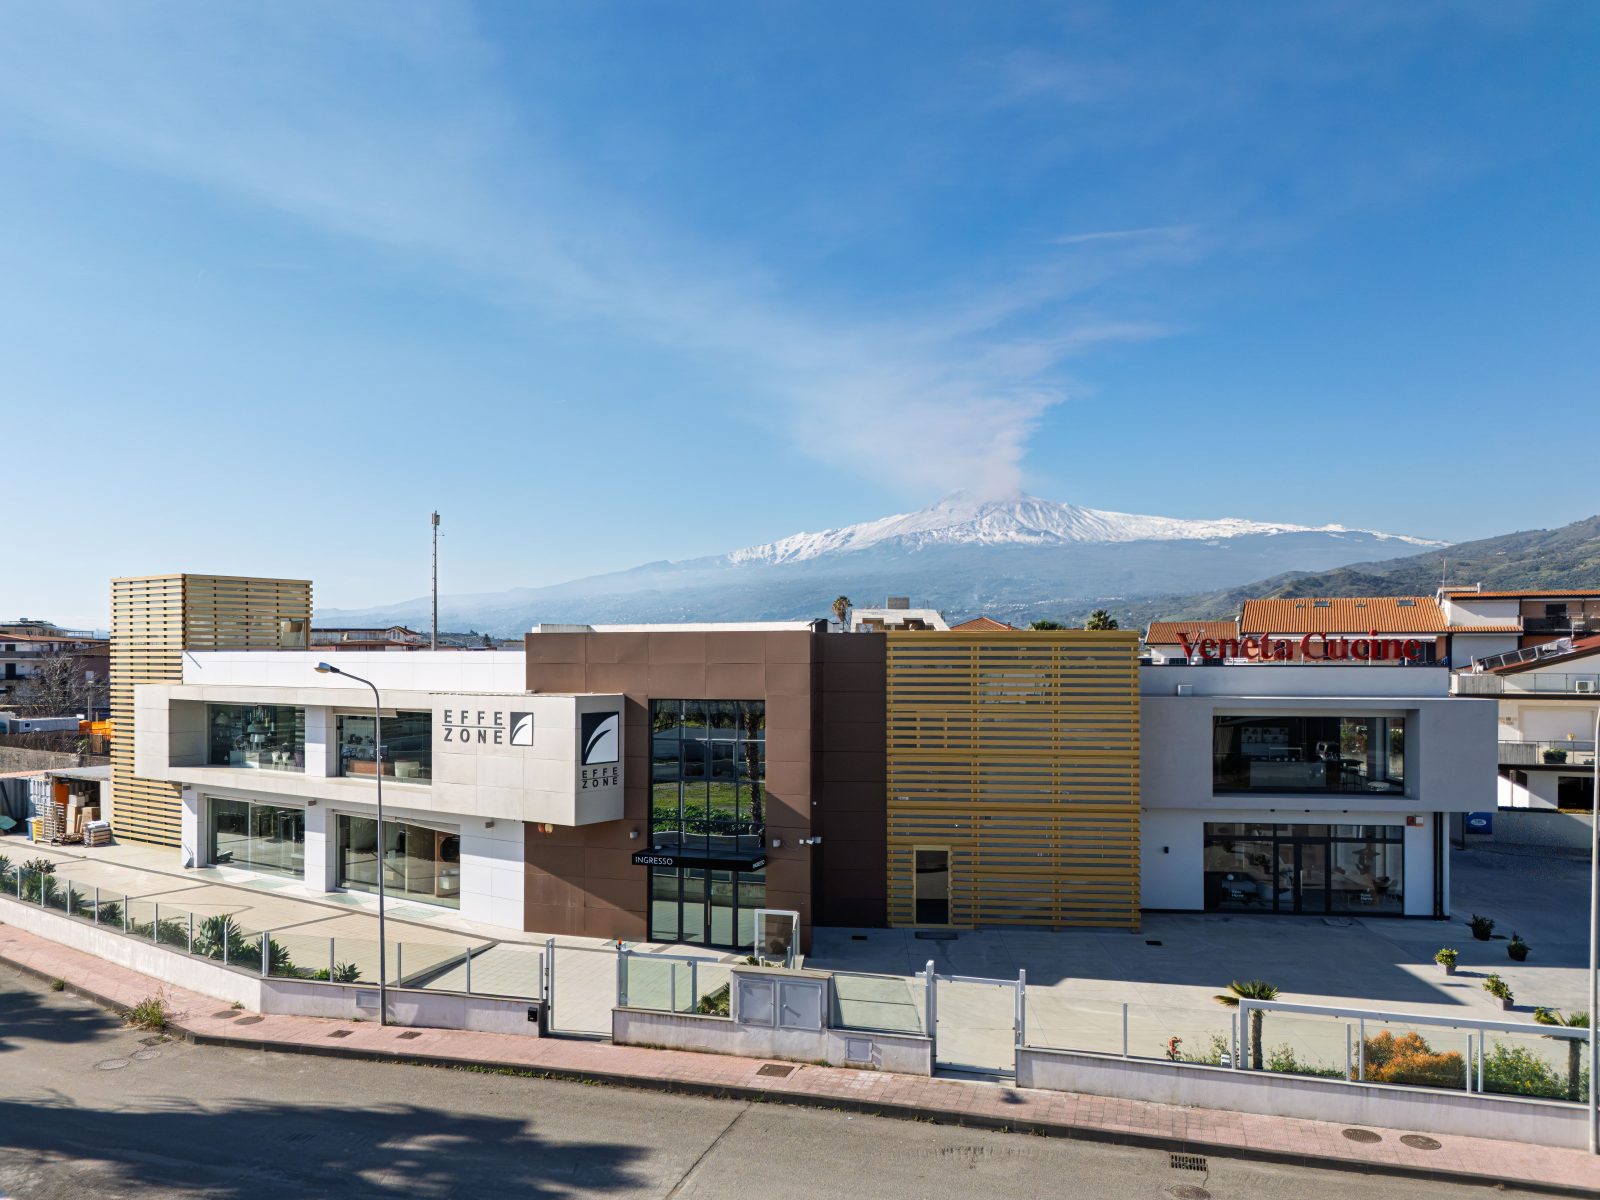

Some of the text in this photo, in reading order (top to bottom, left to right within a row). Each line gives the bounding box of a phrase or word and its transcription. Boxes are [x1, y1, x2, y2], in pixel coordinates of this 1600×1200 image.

[1176, 629, 1421, 660] Veneta Cucine
[444, 709, 503, 726] EFFE
[443, 727, 503, 745] ZONE
[581, 767, 618, 779] EFFE
[581, 776, 618, 789] ZONE
[635, 856, 673, 866] INGRESSO
